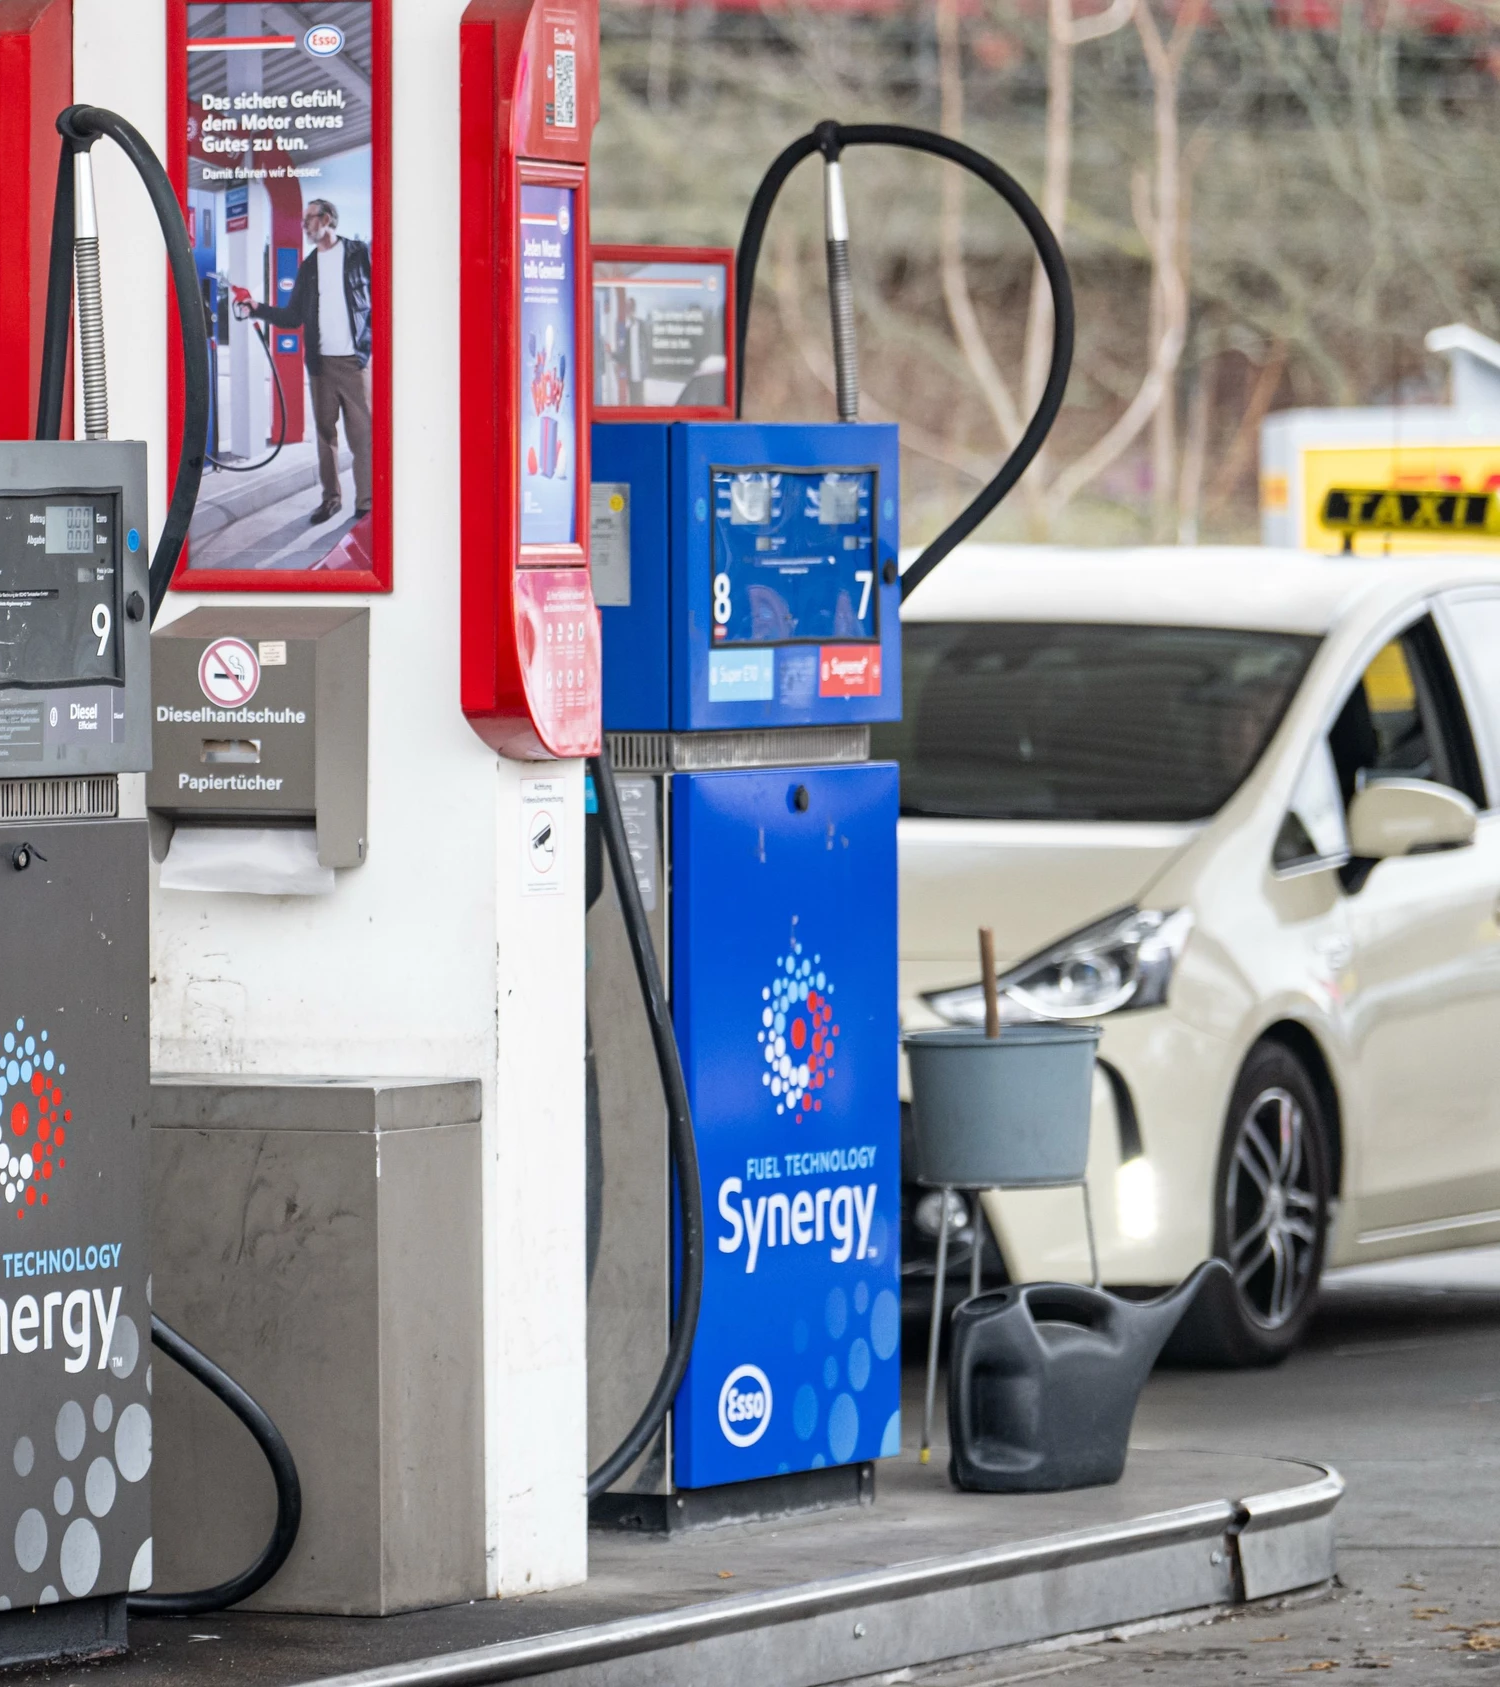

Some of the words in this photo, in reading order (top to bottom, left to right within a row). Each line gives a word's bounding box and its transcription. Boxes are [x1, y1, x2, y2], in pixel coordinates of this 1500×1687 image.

[312, 34, 337, 46] Esso
[202, 93, 231, 111] Das
[234, 91, 288, 110] sichere
[290, 89, 346, 109] Gefühl,
[202, 114, 237, 132] dem
[241, 114, 291, 131] Motor
[295, 114, 343, 129] etwas
[202, 136, 249, 153] Gutes
[253, 138, 273, 151] zu
[276, 136, 309, 150] tun.
[202, 167, 233, 180] Damit
[234, 165, 266, 179] fahren
[269, 166, 285, 178] wir
[287, 166, 322, 178] besser.
[1346, 492, 1468, 526] TAXI
[30, 514, 46, 525] Betrag
[96, 514, 107, 523] Euro
[27, 536, 45, 546] Abgabe
[96, 536, 107, 545] Liter
[714, 572, 732, 624] 8
[855, 571, 873, 620] 7
[91, 603, 111, 657] 9
[70, 704, 98, 720] Diesel
[156, 706, 306, 724] Dieselhandschuhe
[78, 721, 98, 730] Efficient
[178, 773, 283, 793] Papiertücher
[746, 1156, 781, 1181] FUEL
[784, 1146, 877, 1177] TECHNOLOGY
[718, 1176, 878, 1274] Synergy
[3, 1243, 122, 1278] TECHNOLOGY
[727, 1387, 764, 1422] Esso
